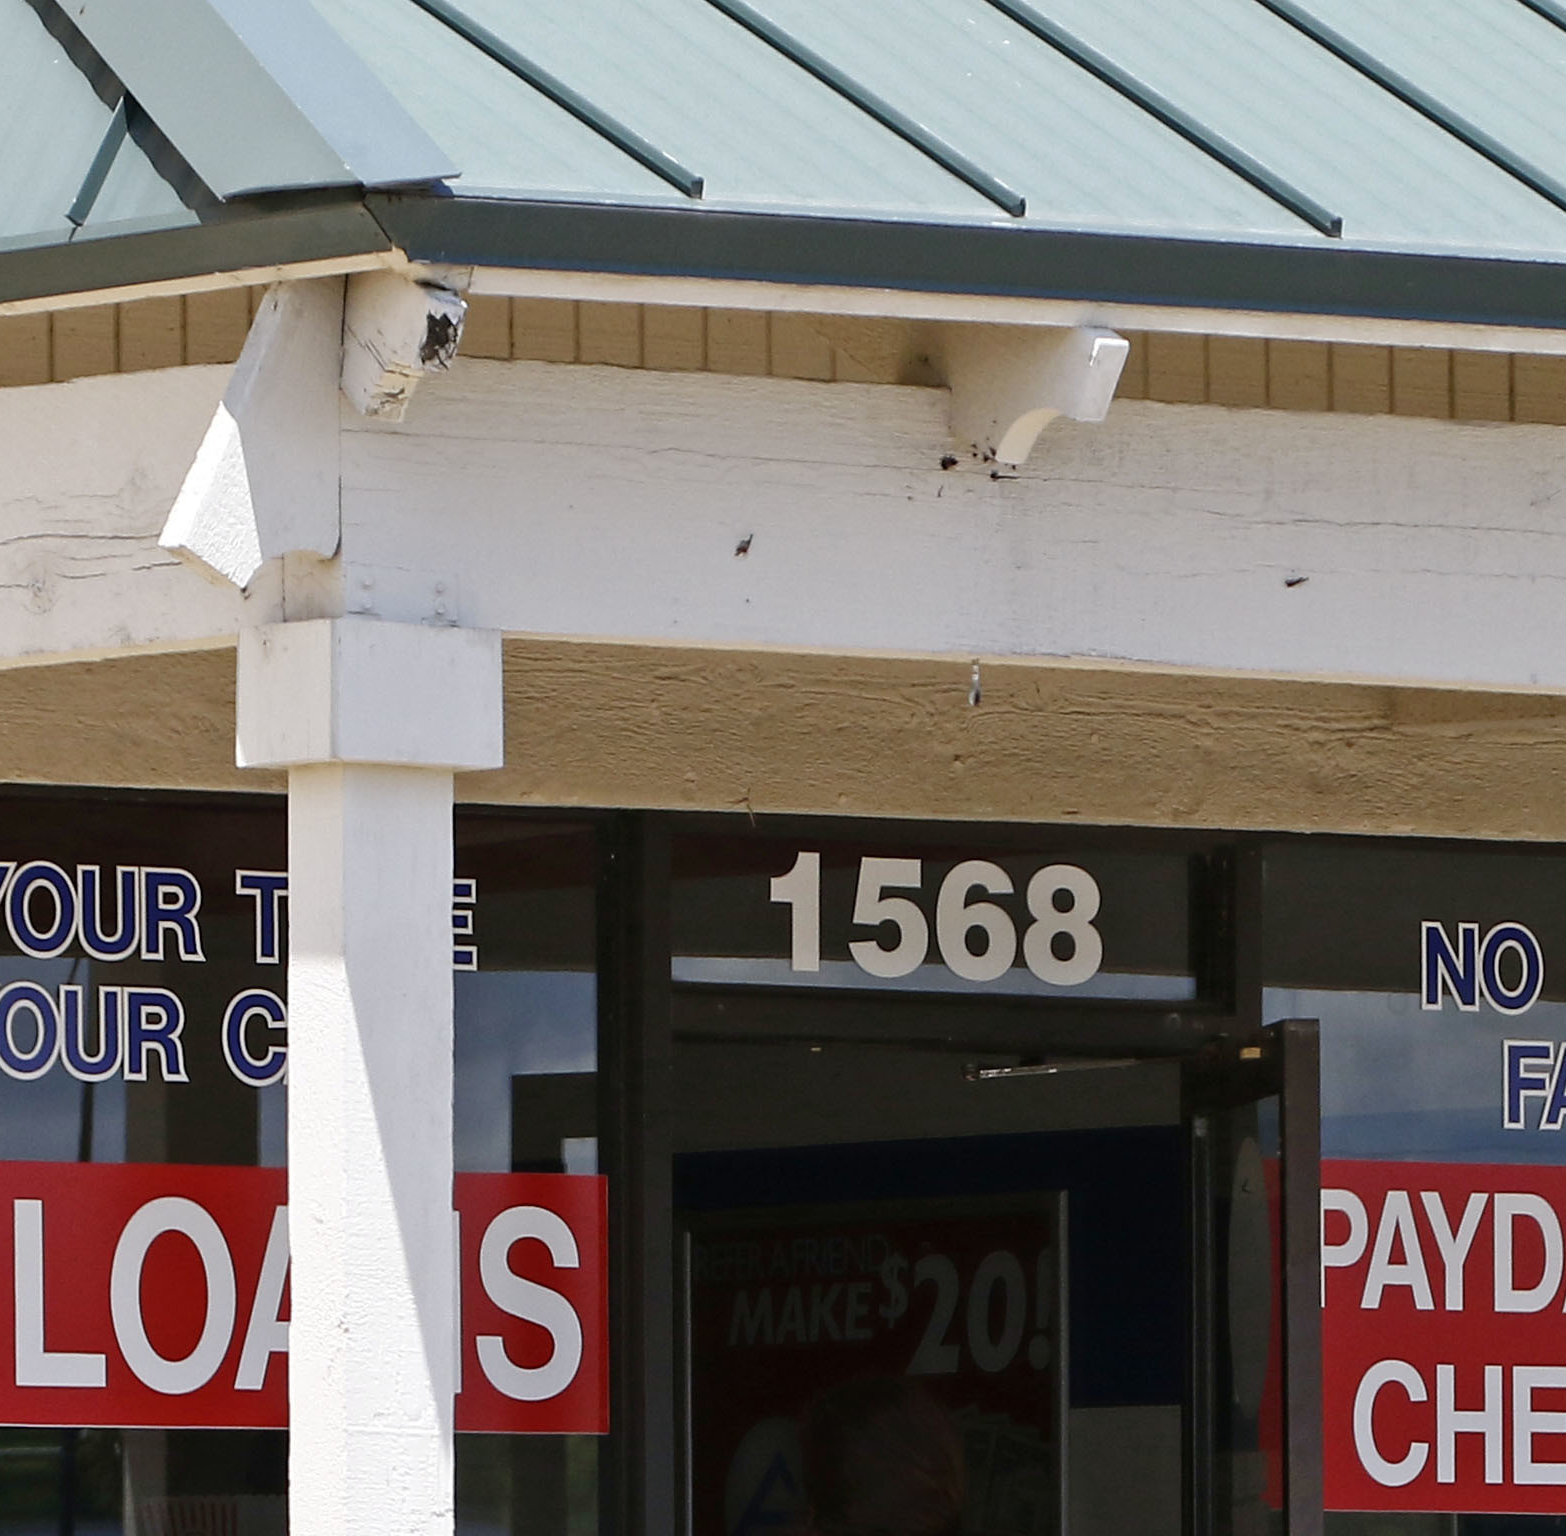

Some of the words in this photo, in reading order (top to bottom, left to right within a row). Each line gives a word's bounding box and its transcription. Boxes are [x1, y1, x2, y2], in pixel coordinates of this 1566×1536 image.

[769, 851, 1104, 986] 1568
[1420, 921, 1545, 1015] NO
[728, 1282, 874, 1350] MAKE
